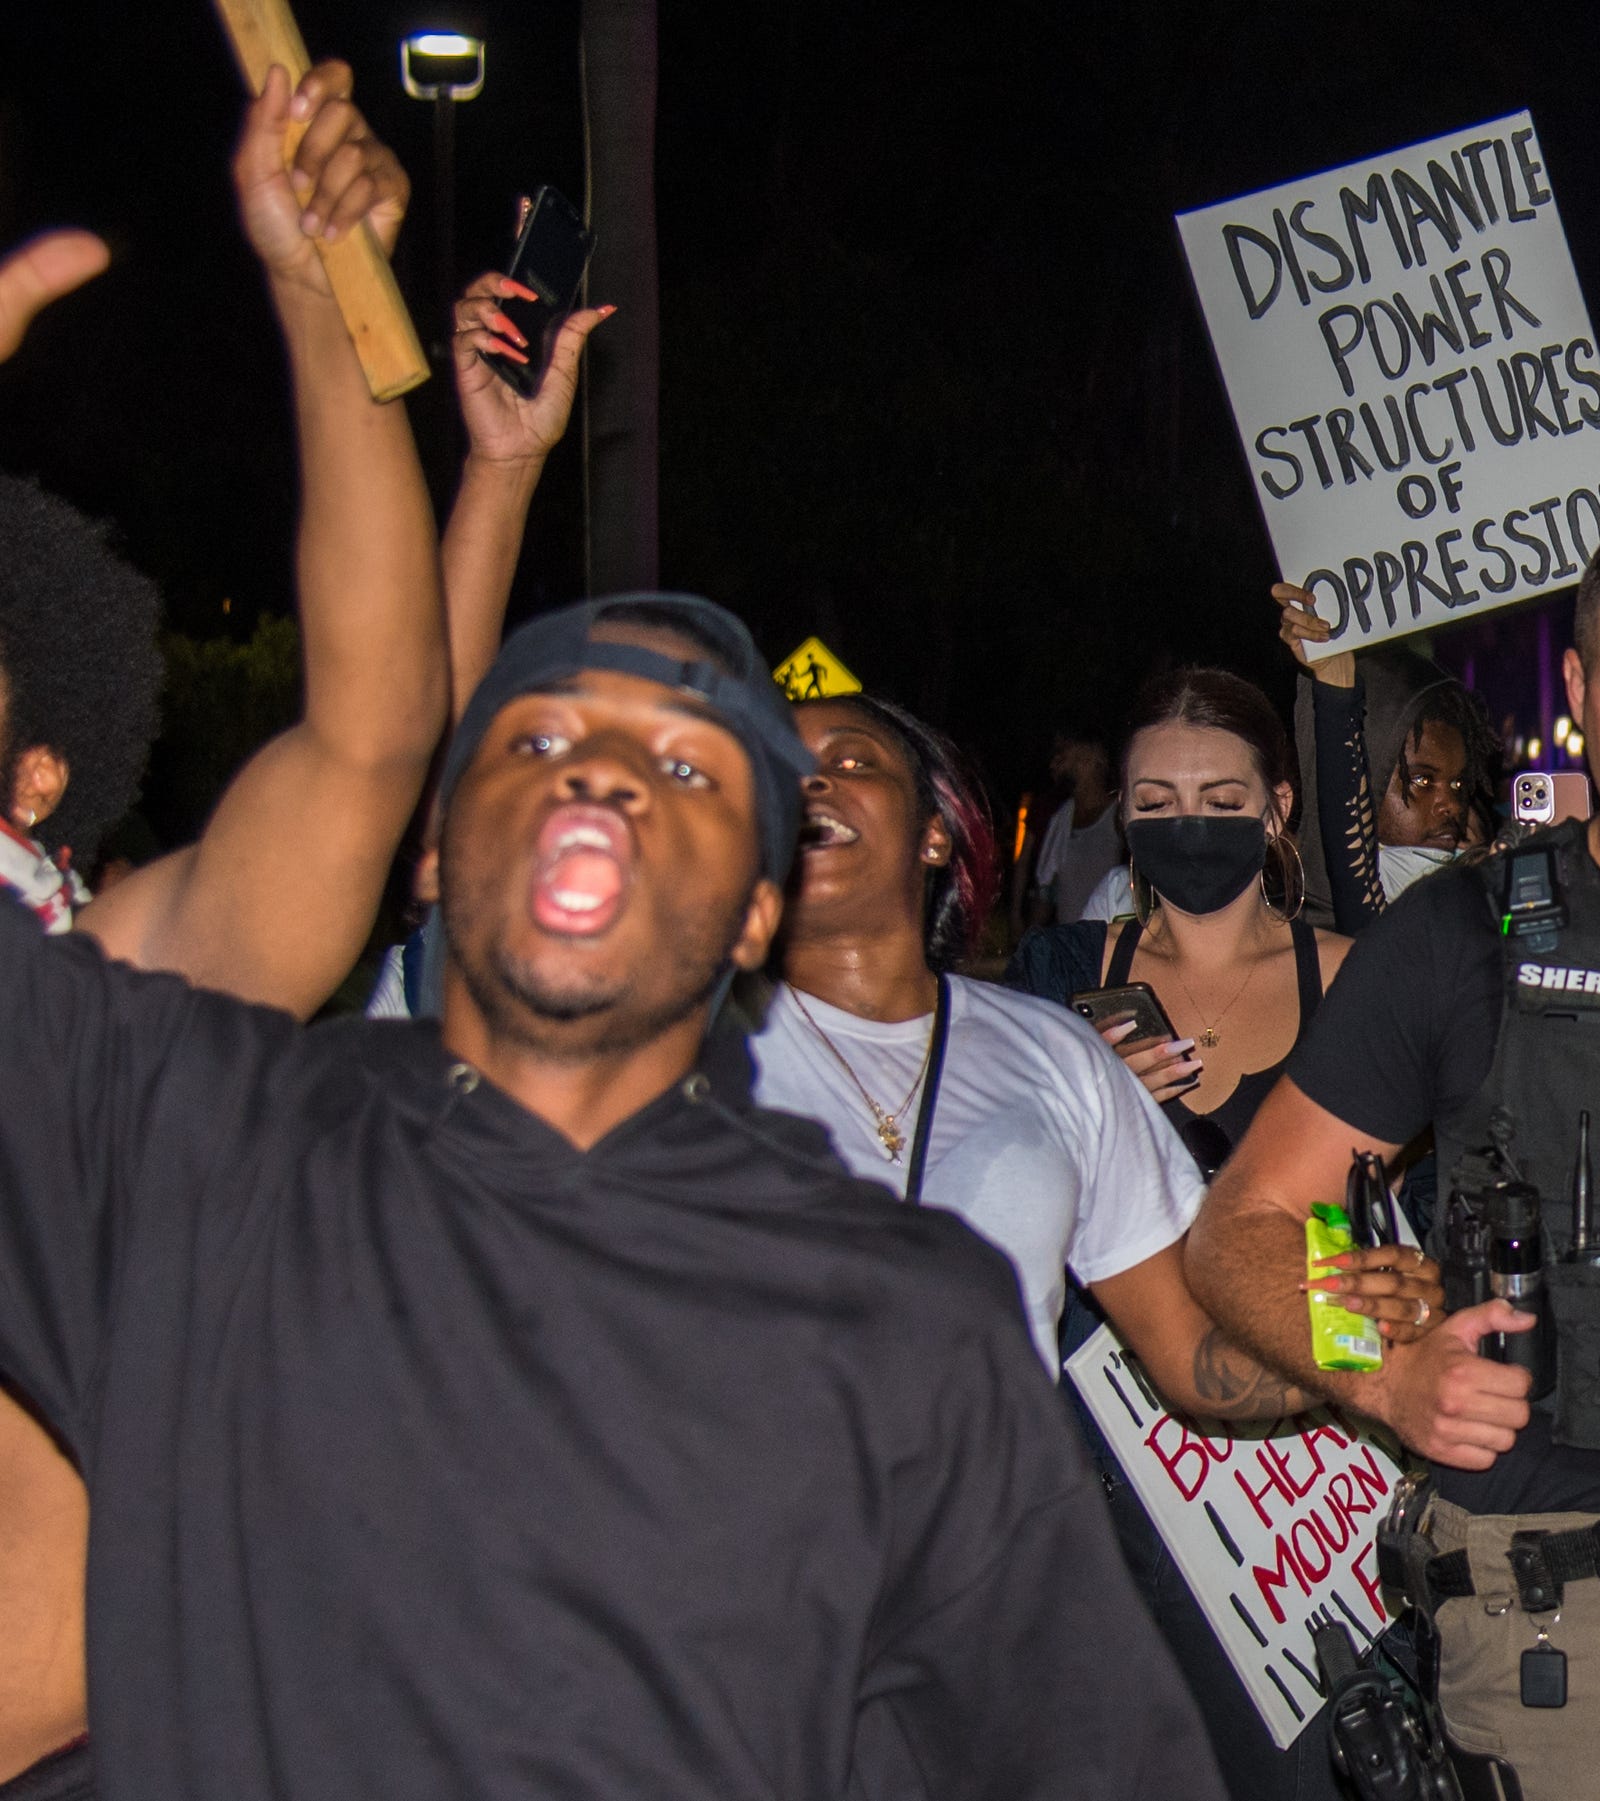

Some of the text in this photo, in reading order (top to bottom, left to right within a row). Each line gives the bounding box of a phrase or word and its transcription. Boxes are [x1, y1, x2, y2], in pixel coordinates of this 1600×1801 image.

[1222, 127, 1552, 320] DISMANTLE
[1318, 247, 1542, 397] POWER
[1396, 461, 1463, 519] OF
[1203, 1403, 1359, 1567] I HEA
[1230, 1592, 1269, 1648] I
[1252, 1443, 1389, 1625] MOURN
